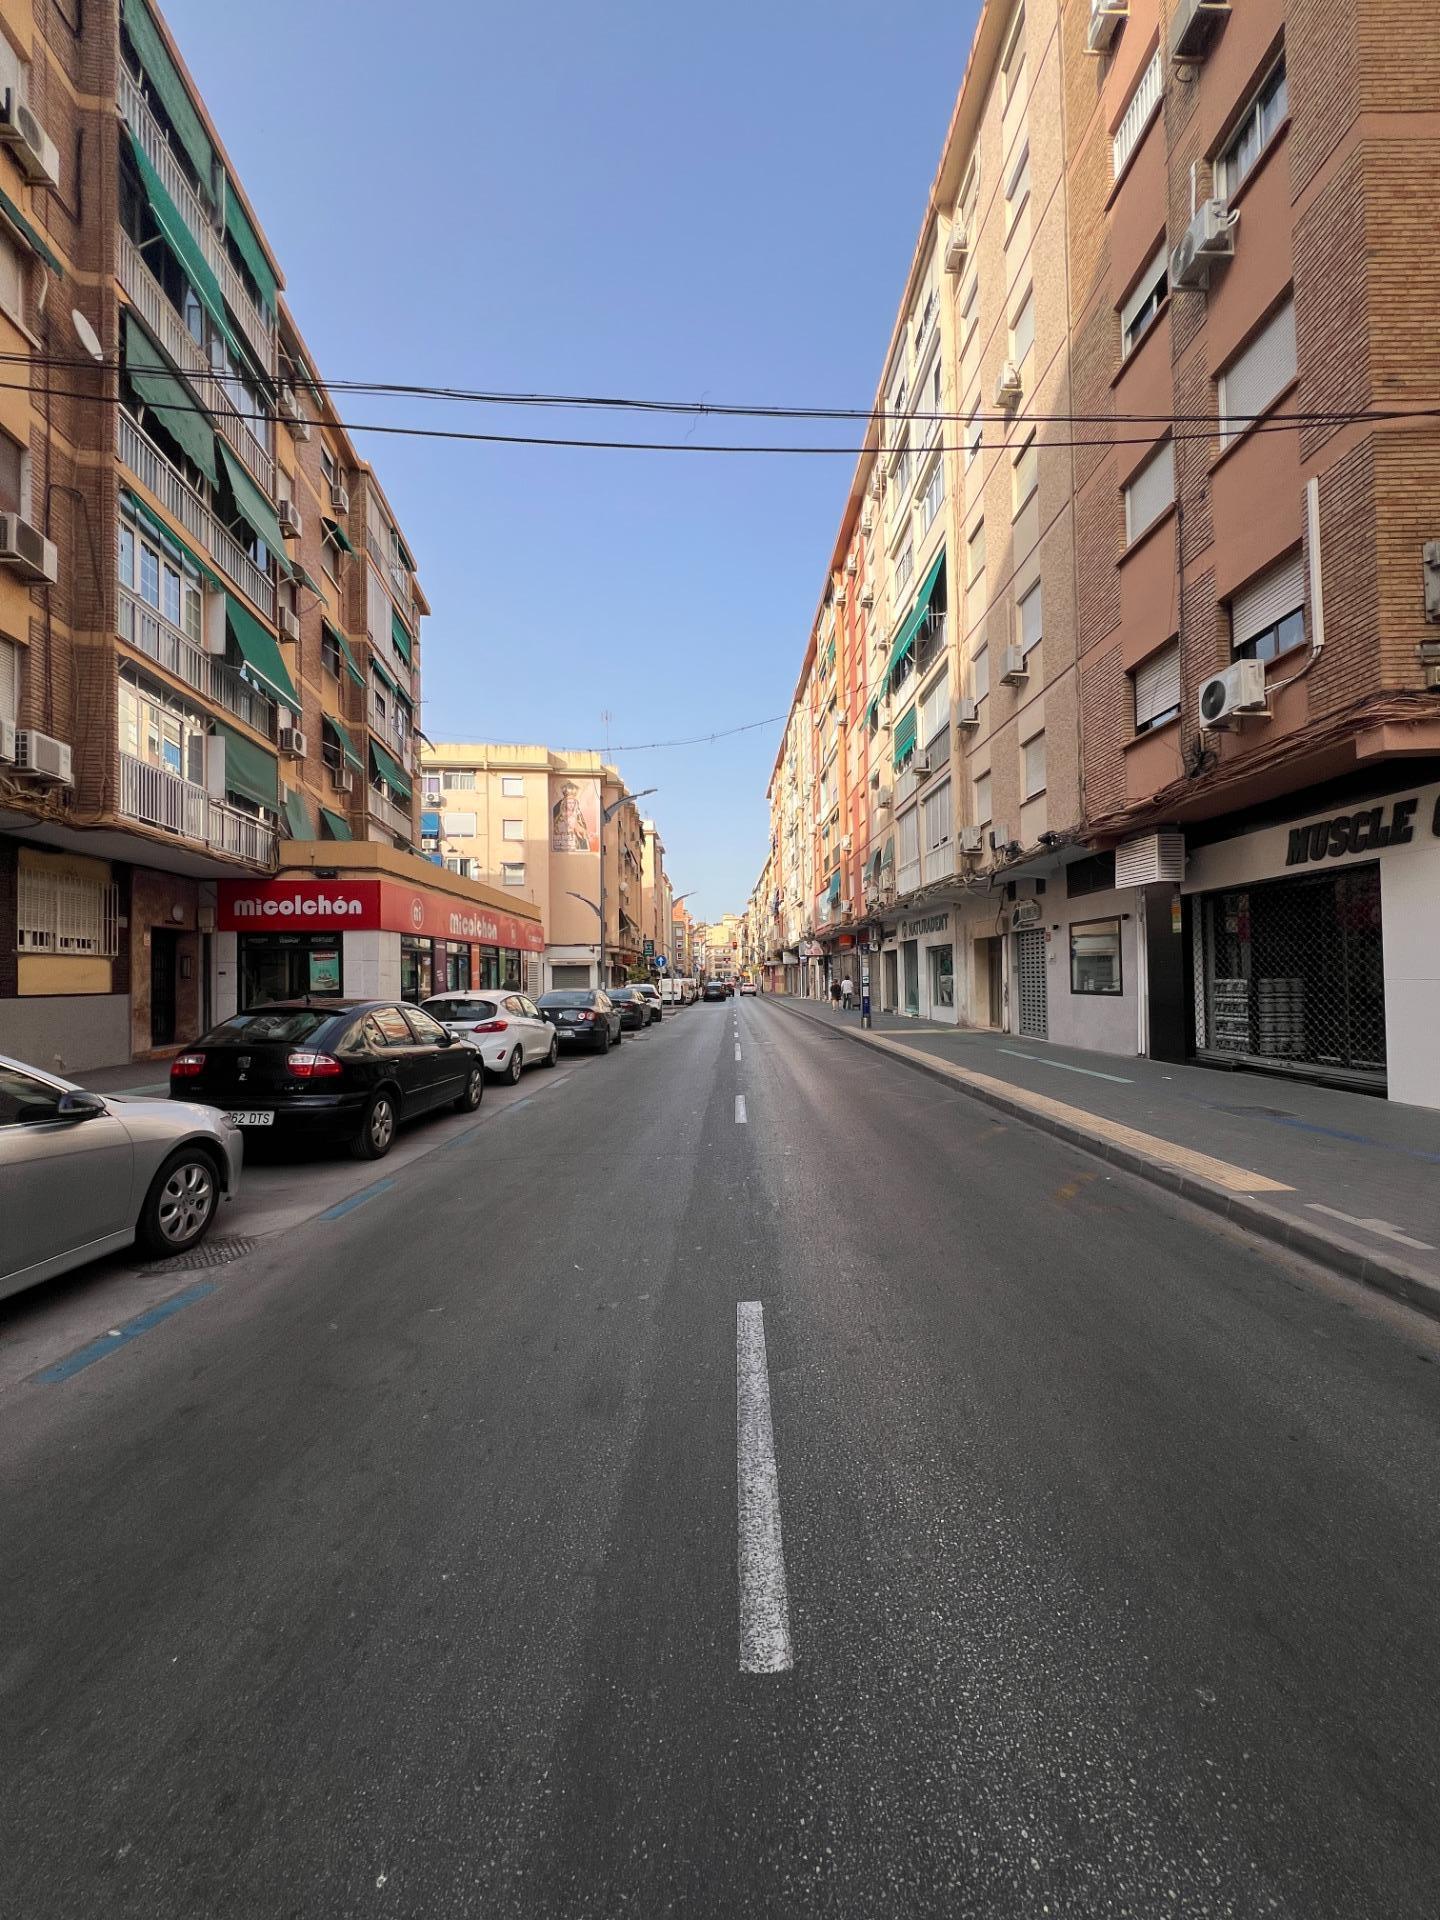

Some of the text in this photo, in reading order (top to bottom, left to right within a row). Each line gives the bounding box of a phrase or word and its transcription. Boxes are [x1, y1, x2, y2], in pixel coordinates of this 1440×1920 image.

[1286, 798, 1418, 866] MUSCLE
[234, 895, 362, 916] micolchón
[449, 912, 498, 940] micolchón
[249, 1113, 270, 1124] DTS
